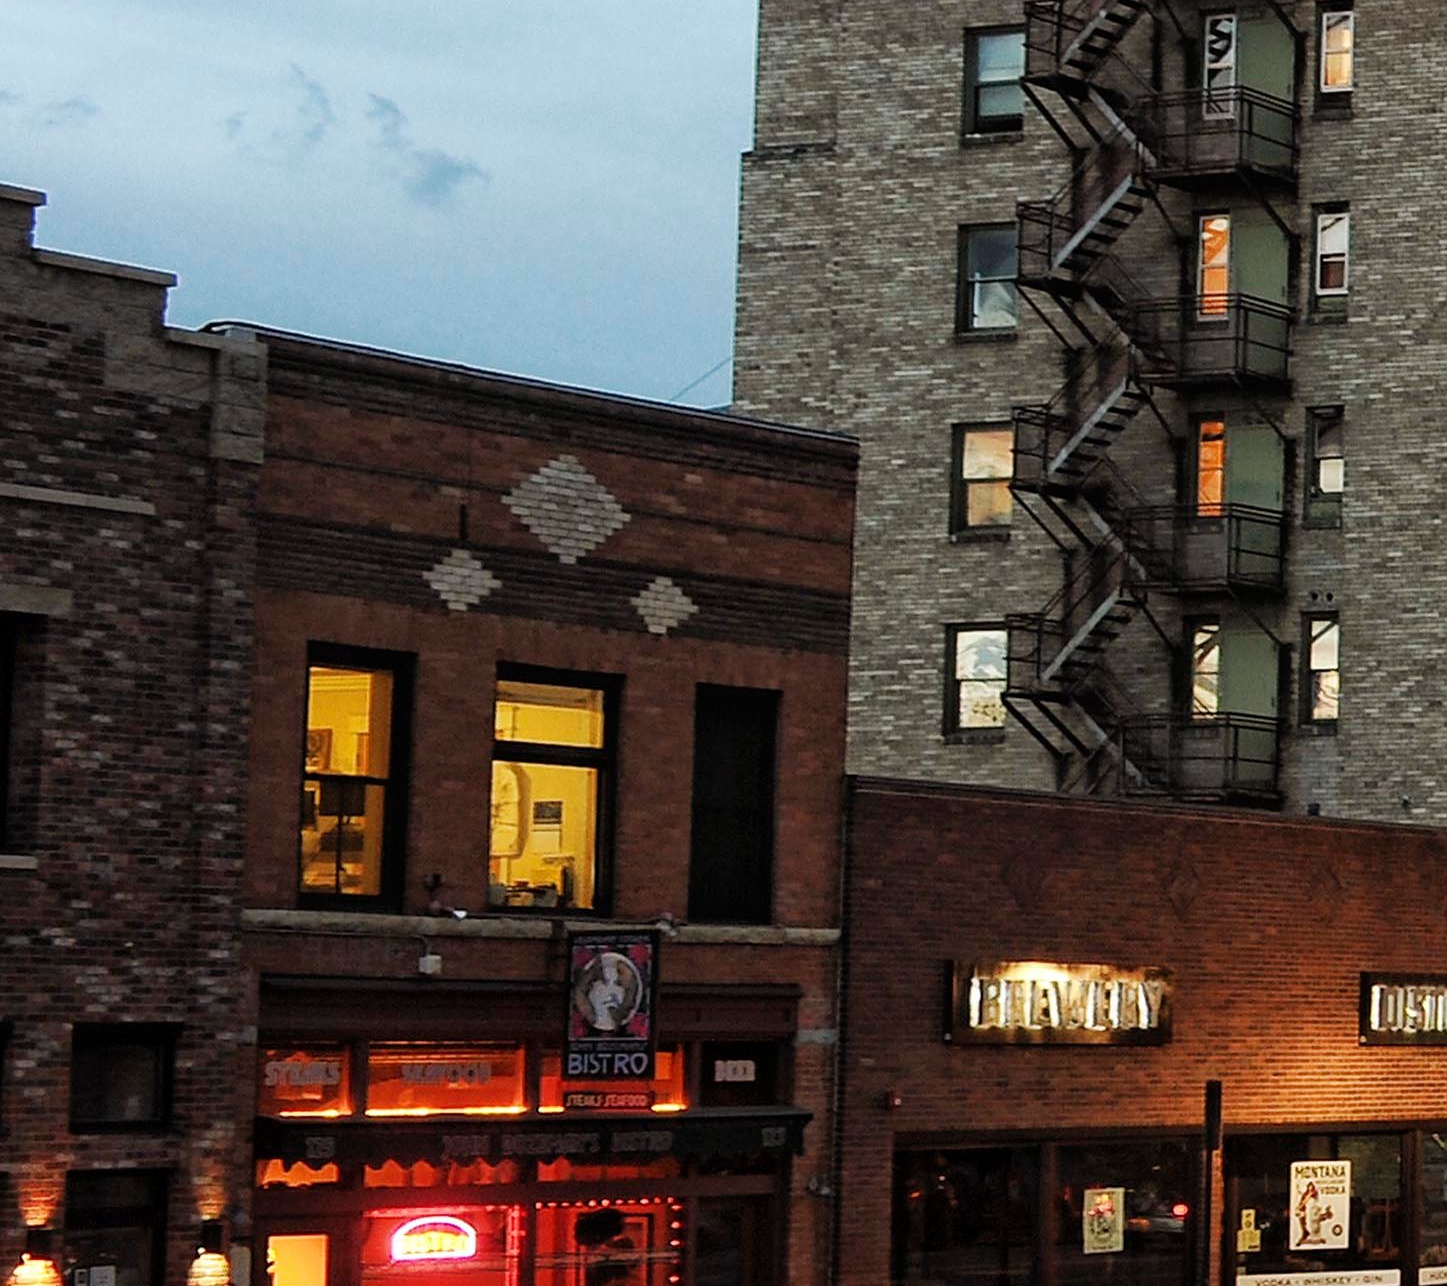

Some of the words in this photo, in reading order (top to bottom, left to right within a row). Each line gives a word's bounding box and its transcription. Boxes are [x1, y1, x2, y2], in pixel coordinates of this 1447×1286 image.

[969, 977, 1164, 1030] BREWERY
[567, 1051, 650, 1076] BISTRO
[1295, 1165, 1347, 1179] MONTANA
[1319, 1186, 1346, 1195] VODKA
[1303, 1276, 1352, 1286] WHISKEY
[1362, 1275, 1384, 1285] GIN
